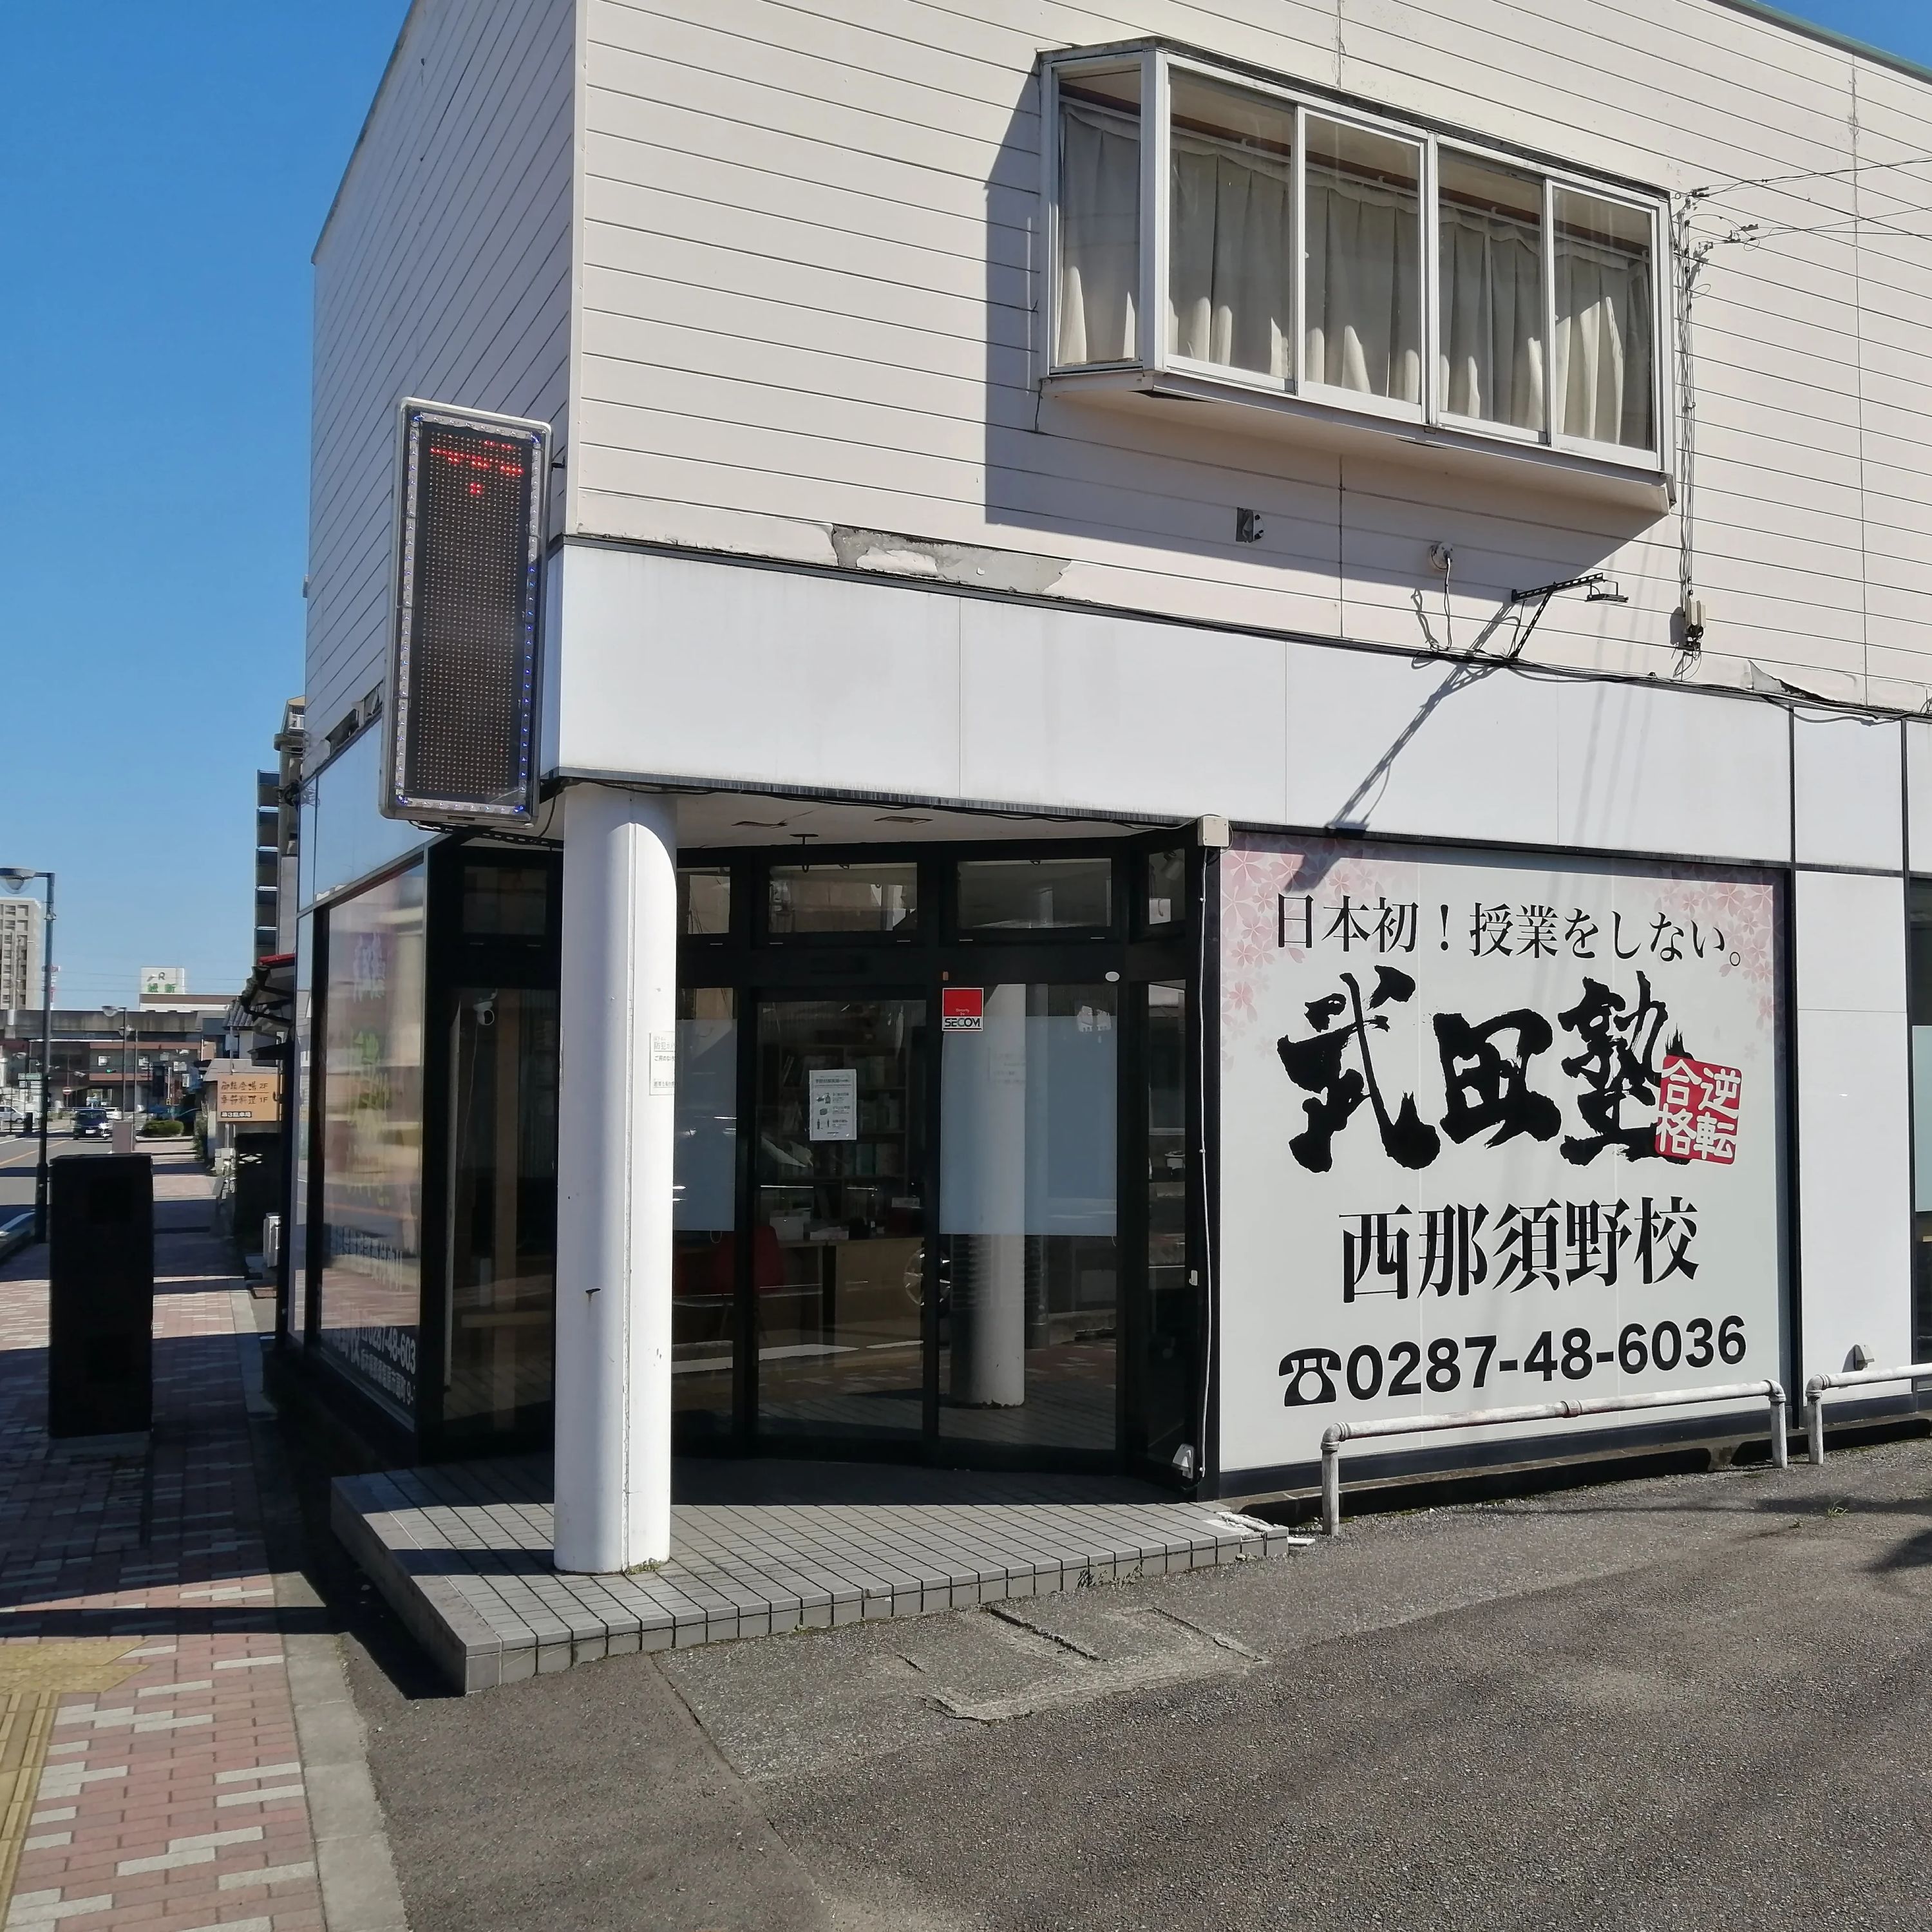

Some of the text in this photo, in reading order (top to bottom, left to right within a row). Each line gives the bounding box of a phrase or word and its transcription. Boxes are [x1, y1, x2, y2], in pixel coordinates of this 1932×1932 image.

[1277, 893, 1741, 967] 日本初！授業をしない。
[945, 1018, 980, 1027] SECOM
[1276, 965, 1695, 1173] 武田塾
[1655, 1059, 1703, 1156] 合格
[1692, 1066, 1741, 1160] 逆転
[1339, 1196, 1700, 1303] 西那須野校
[1345, 1314, 1747, 1401] 0287-48-6036
